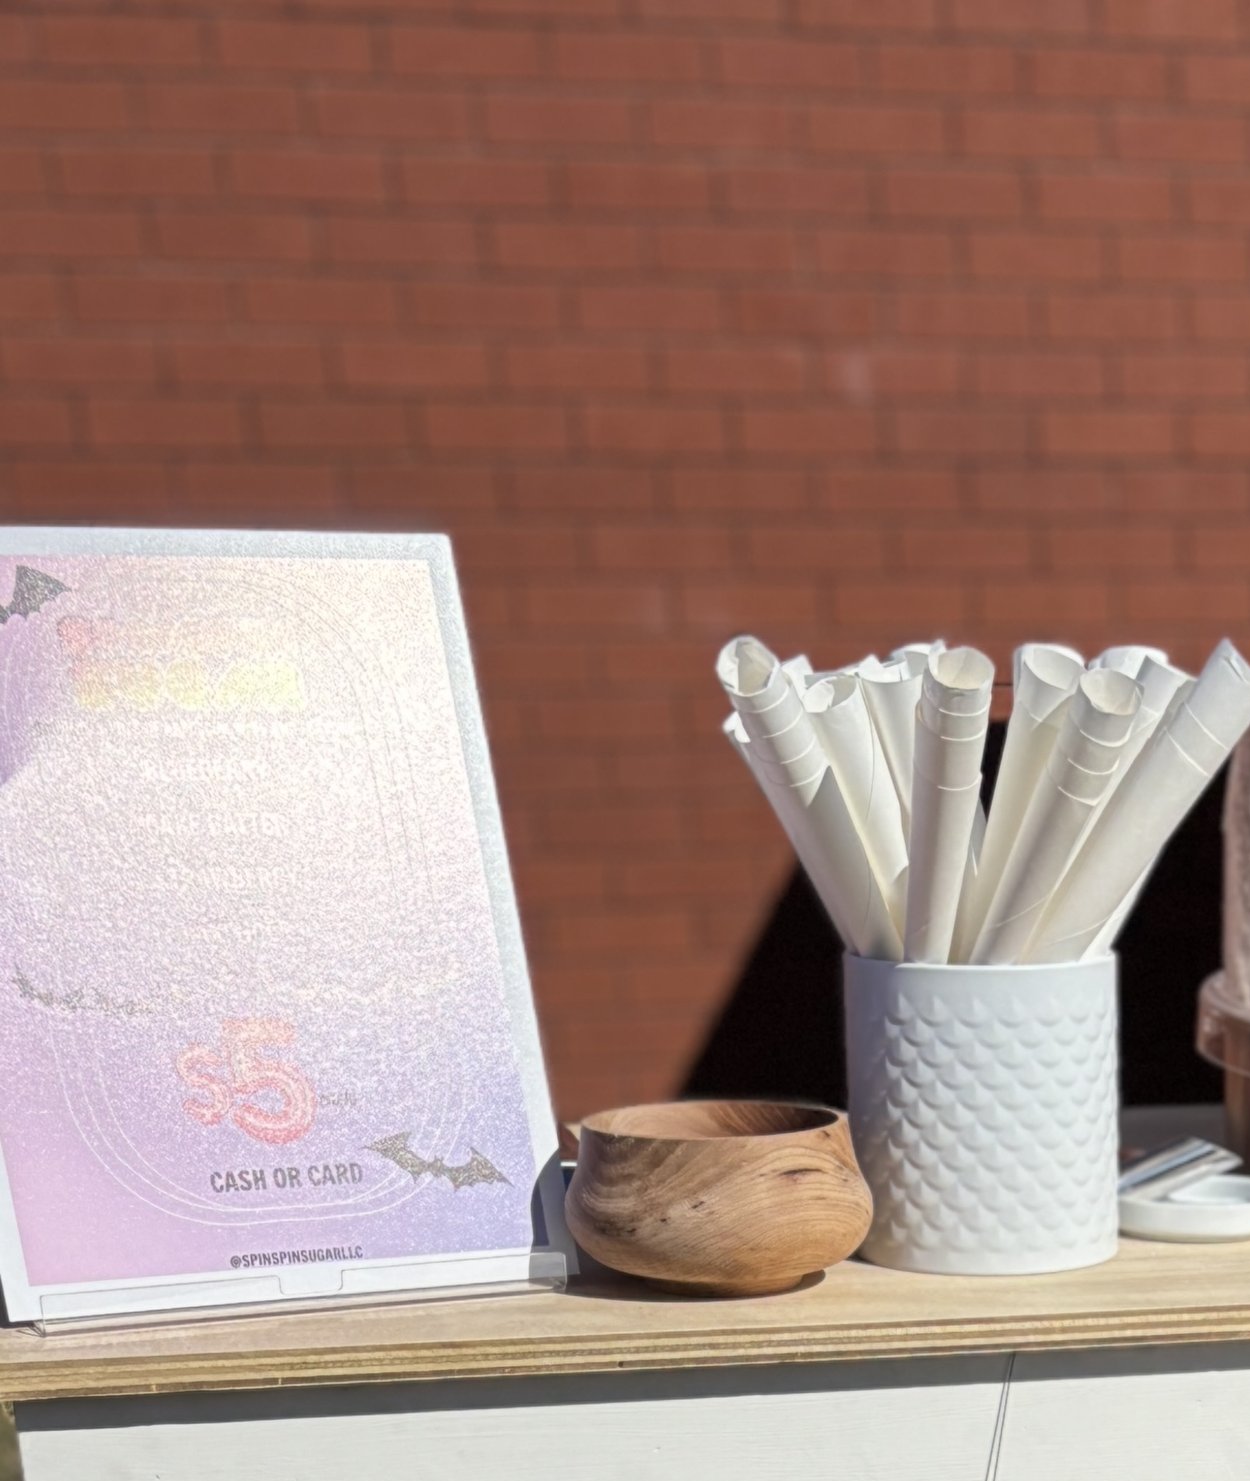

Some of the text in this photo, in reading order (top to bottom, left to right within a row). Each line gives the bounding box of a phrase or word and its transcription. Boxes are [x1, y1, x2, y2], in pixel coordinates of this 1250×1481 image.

[209, 1162, 364, 1193] CASH OR CARD
[229, 1246, 364, 1269] @SPINSPINSUGARLLC
